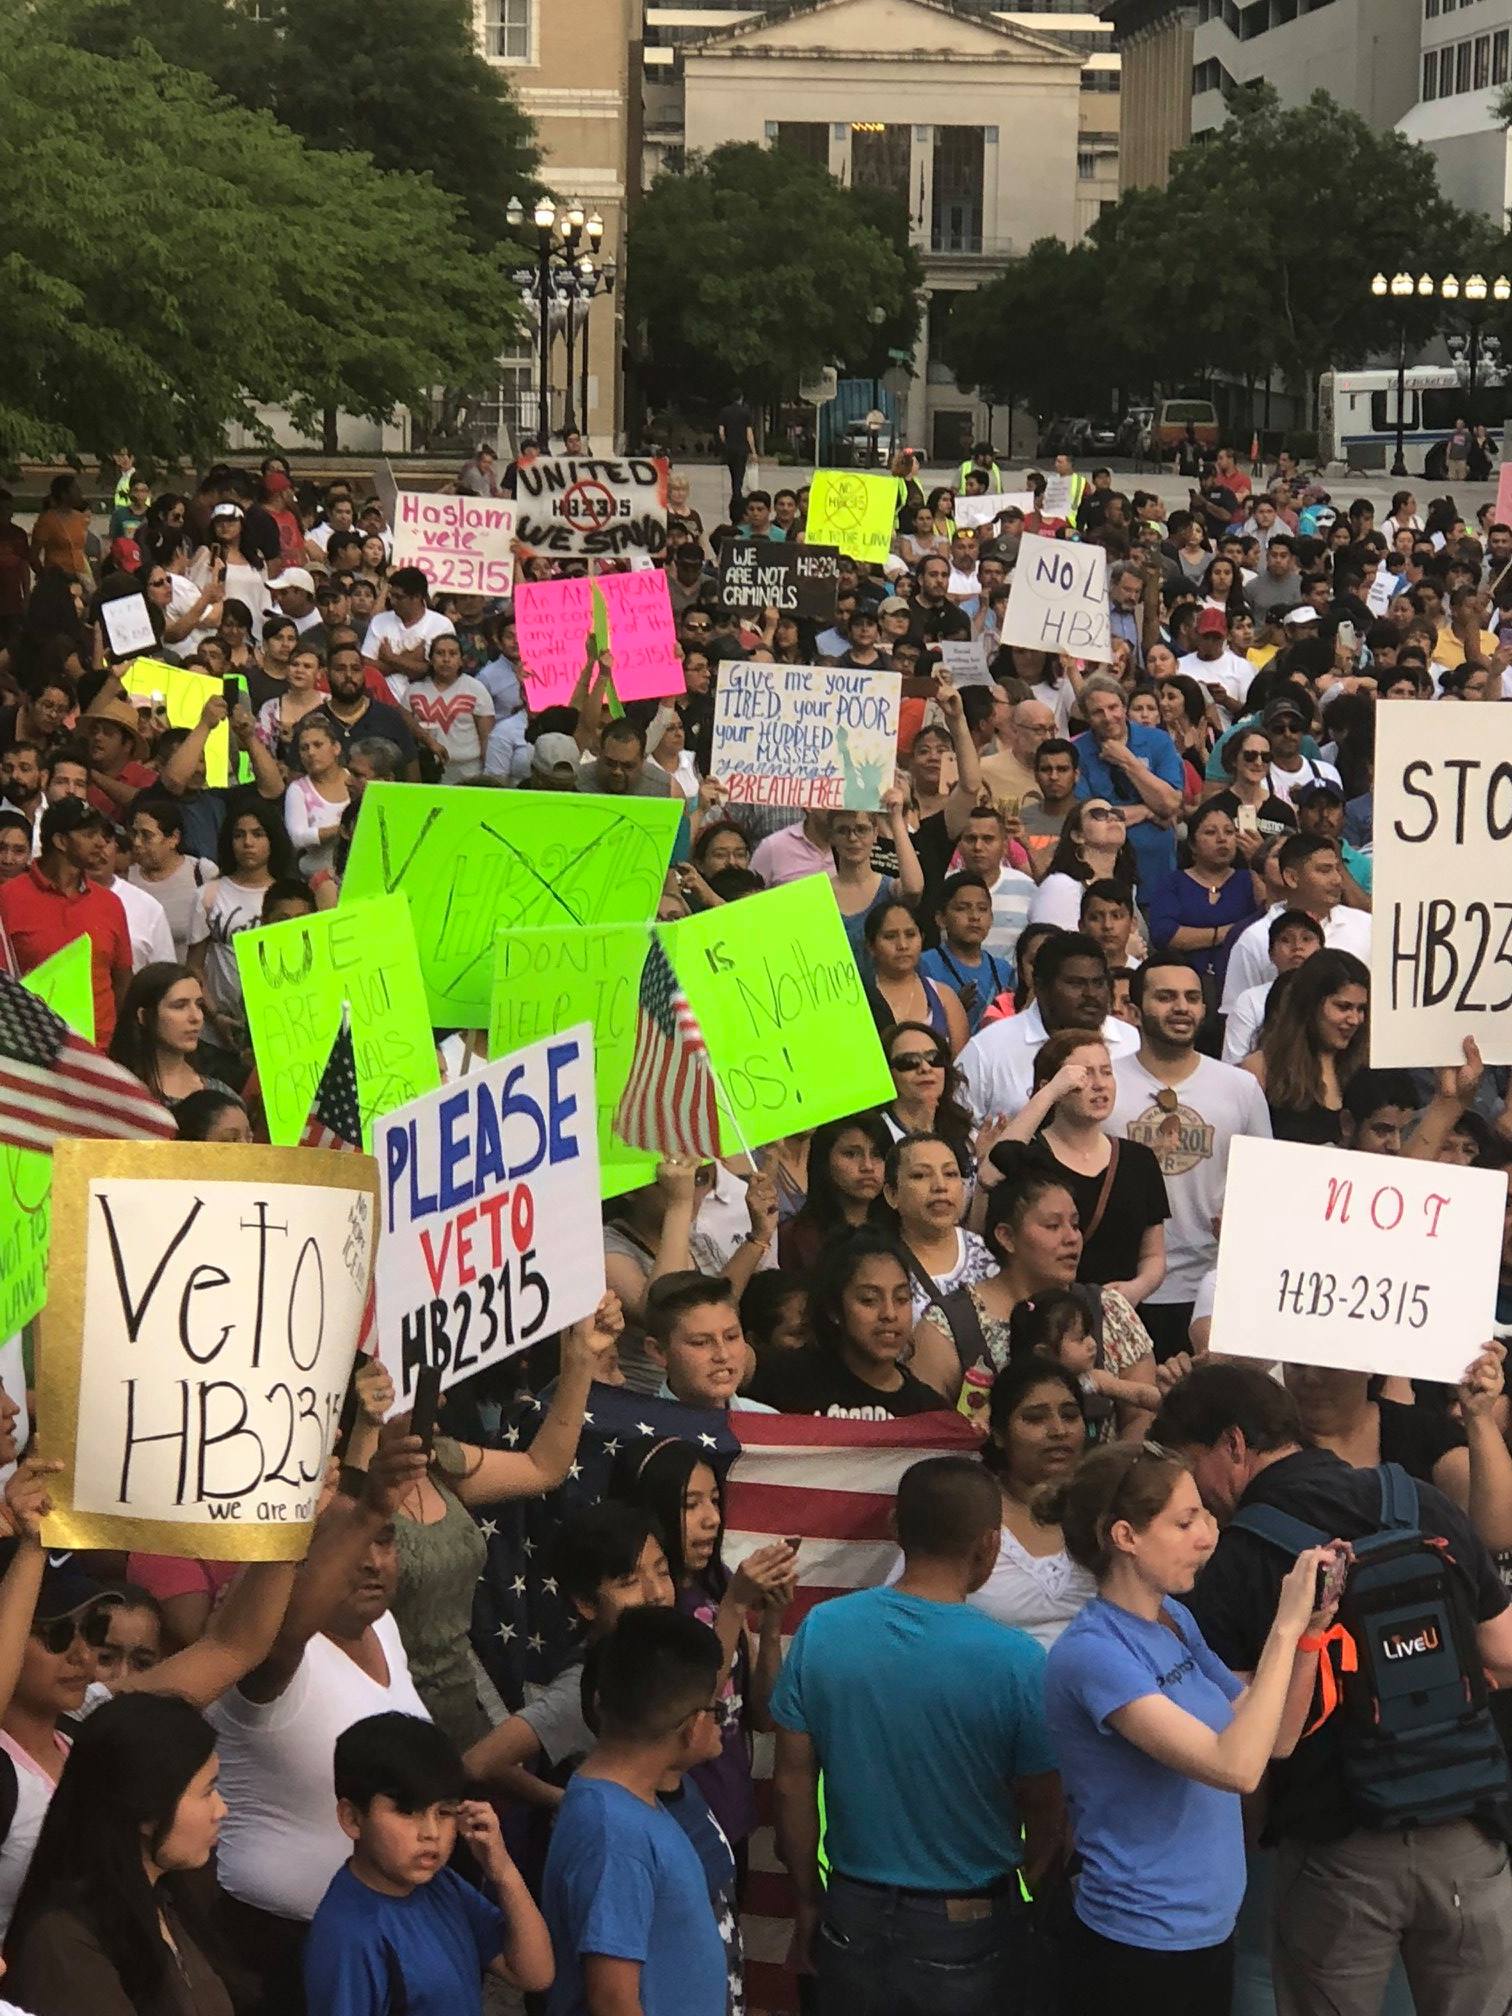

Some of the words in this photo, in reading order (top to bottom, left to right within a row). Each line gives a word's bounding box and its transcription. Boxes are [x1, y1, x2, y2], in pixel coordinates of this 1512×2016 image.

[518, 460, 658, 496] UNITED
[402, 496, 512, 531] Haslam
[516, 515, 575, 551] WE
[733, 547, 758, 566] WE
[1036, 554, 1074, 591] NO
[725, 567, 753, 585] ARE
[757, 566, 789, 588] NOT
[722, 586, 798, 609] CRIMINALS
[826, 674, 872, 695] your
[794, 700, 832, 724] your
[716, 722, 754, 749] your
[758, 721, 833, 750] HUDDLED
[727, 773, 805, 806] BREATHE
[258, 914, 362, 989] WE
[494, 930, 625, 984] DONT
[263, 993, 330, 1064] ARE
[386, 1041, 580, 1234] PLEASE
[1325, 1177, 1451, 1237] NOT
[419, 1183, 535, 1297] VETO
[1277, 1269, 1431, 1329] HB-2315
[401, 1249, 551, 1398] HB2315
[208, 1501, 242, 1520] we
[256, 1502, 287, 1521] are
[1383, 1627, 1439, 1659] LiveU
